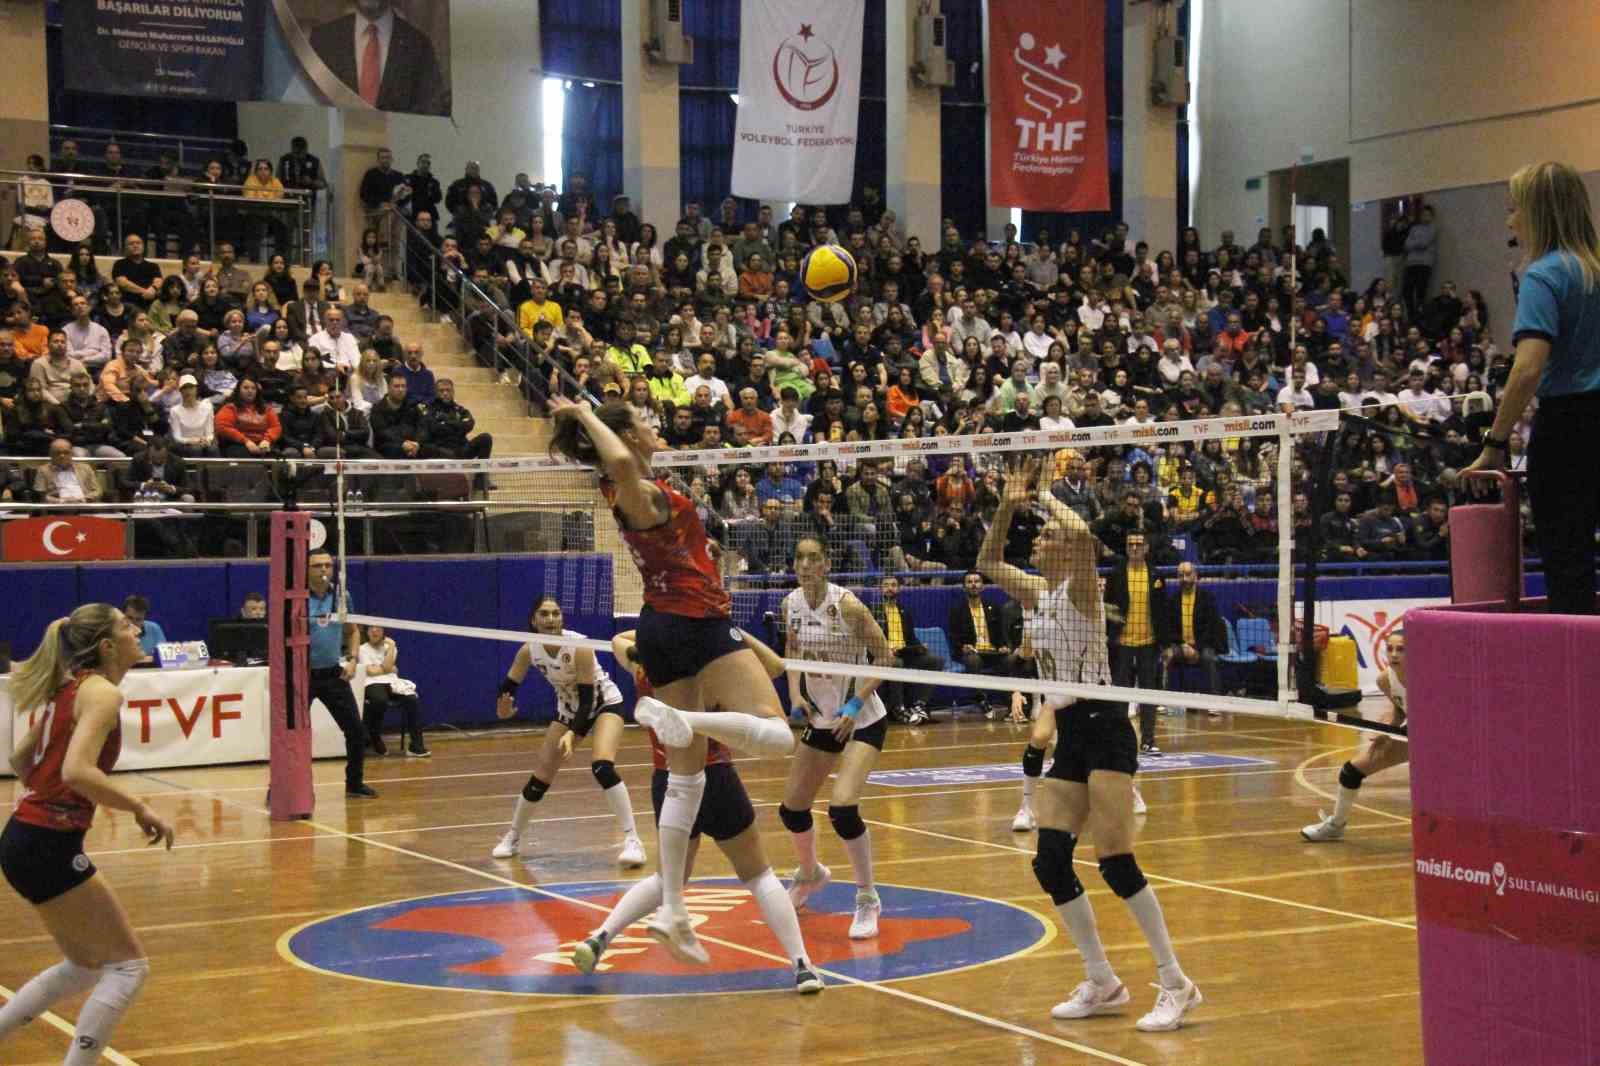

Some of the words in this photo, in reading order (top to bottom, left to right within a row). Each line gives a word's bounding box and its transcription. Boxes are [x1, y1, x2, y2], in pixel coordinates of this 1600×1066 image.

[96, 0, 170, 16] BAŞARILAR
[173, 6, 242, 22] DİLİYORUM
[740, 132, 793, 146] VOLEYBOL
[1016, 118, 1086, 151] THF
[838, 445, 871, 454] misli.com
[902, 440, 938, 451] misli.com
[972, 436, 1012, 448] misli.com
[1048, 431, 1091, 443] misli.com
[1104, 430, 1118, 440] TVF
[1132, 426, 1178, 438] misli.com
[1193, 424, 1209, 434] TVF
[1224, 419, 1276, 432] misli.com
[1292, 416, 1310, 427] TVF
[127, 692, 243, 744] TVF
[1416, 858, 1491, 885] misli.com
